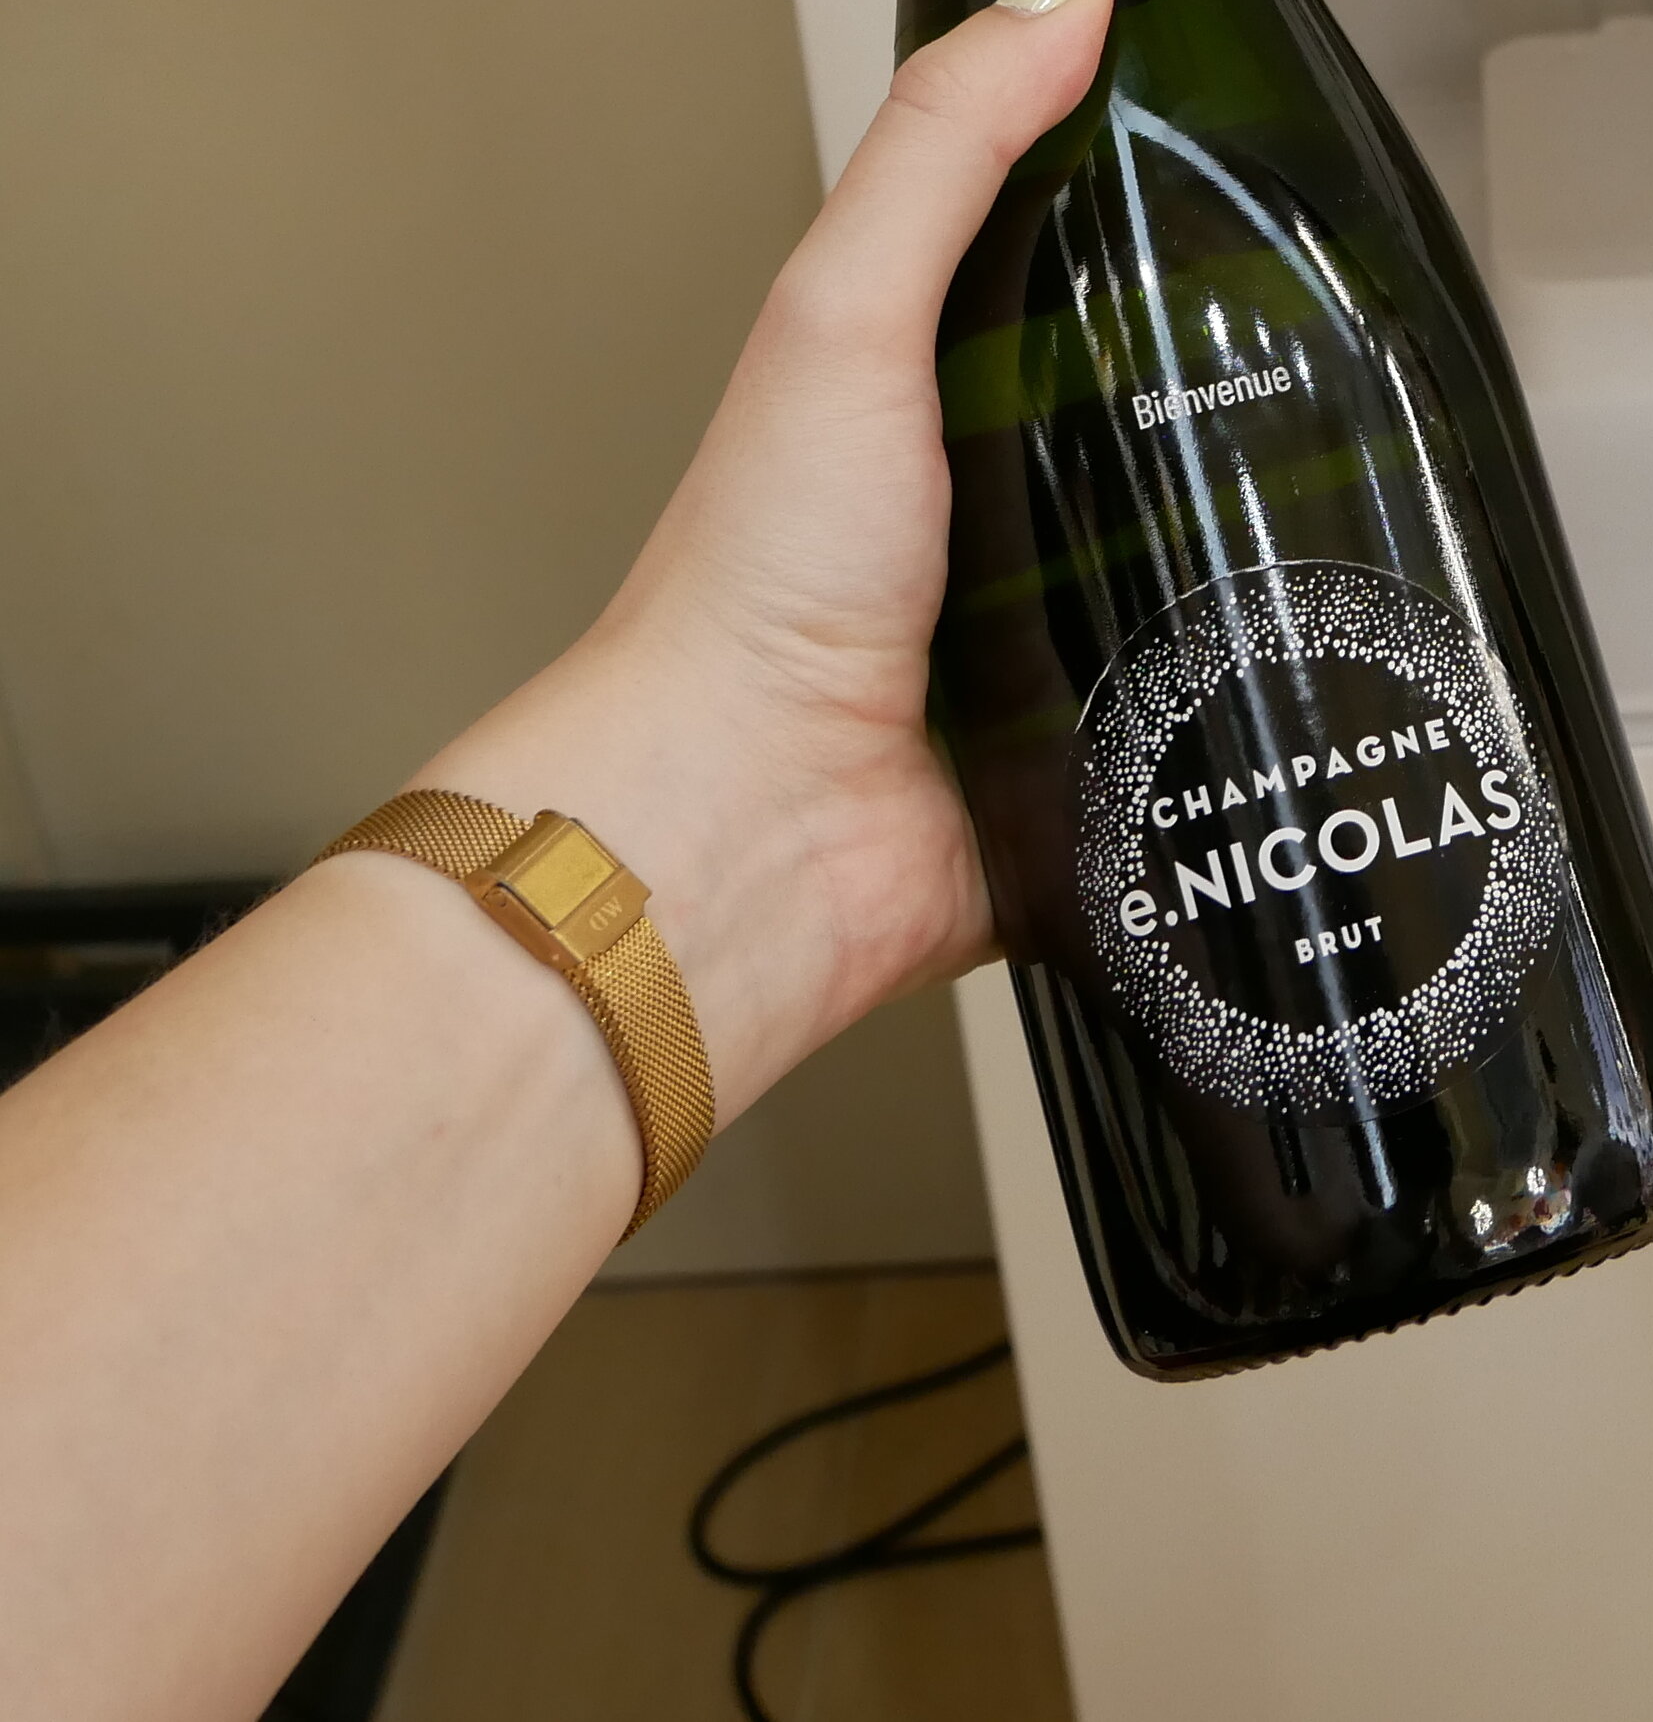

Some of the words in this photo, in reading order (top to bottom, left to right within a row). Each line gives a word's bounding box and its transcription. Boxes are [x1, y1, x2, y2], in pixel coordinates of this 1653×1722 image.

[1132, 365, 1292, 430] Bienvenue
[1150, 718, 1450, 829] CHAMPAGNE
[1118, 770, 1522, 938] e.NICOLAS
[1294, 916, 1384, 964] BRUT
